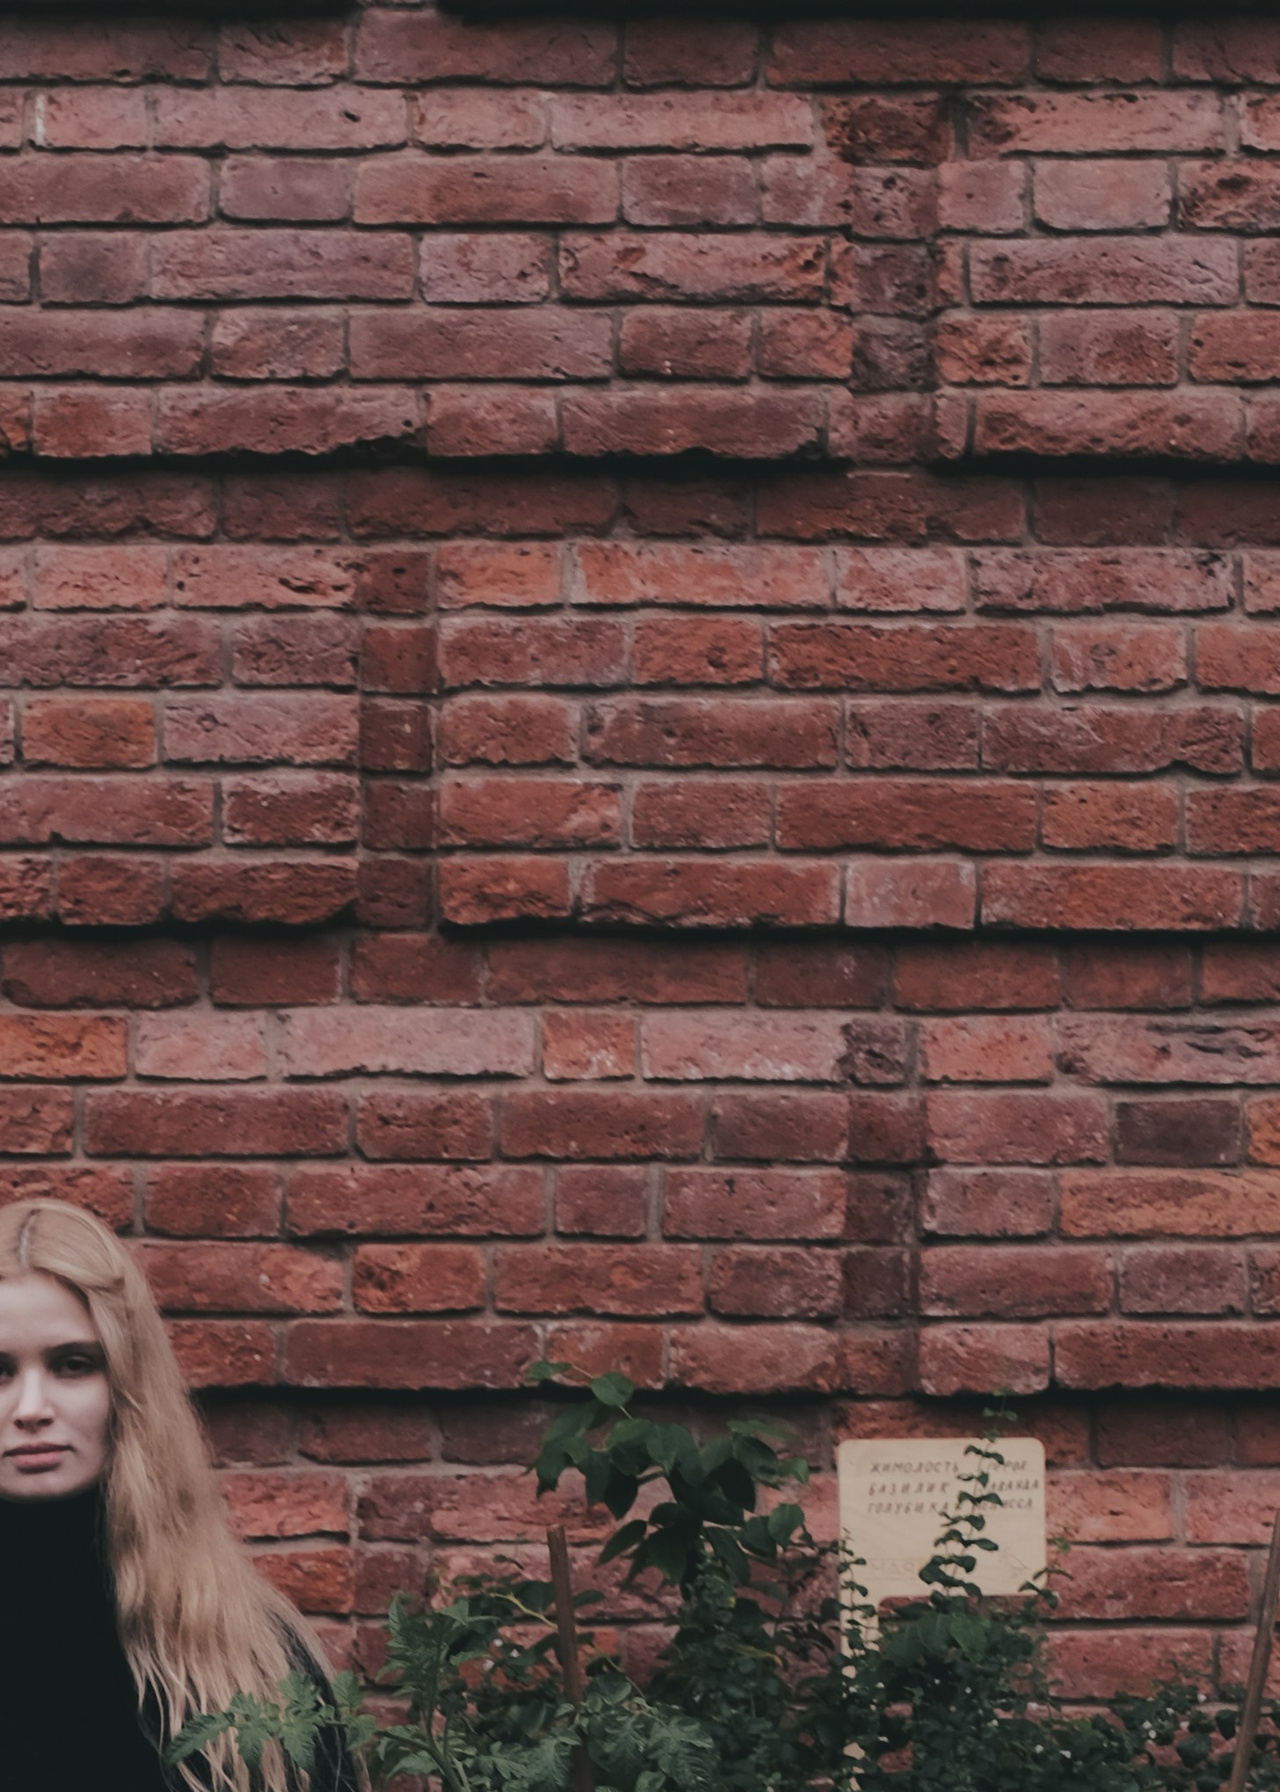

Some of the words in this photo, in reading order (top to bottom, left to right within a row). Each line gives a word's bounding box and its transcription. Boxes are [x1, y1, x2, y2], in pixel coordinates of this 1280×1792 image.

[870, 1461, 960, 1474] ЖИМОЛОСТЬ
[868, 1482, 950, 1496] БАЗИЛИК
[987, 1478, 1039, 1493] АВАНДА
